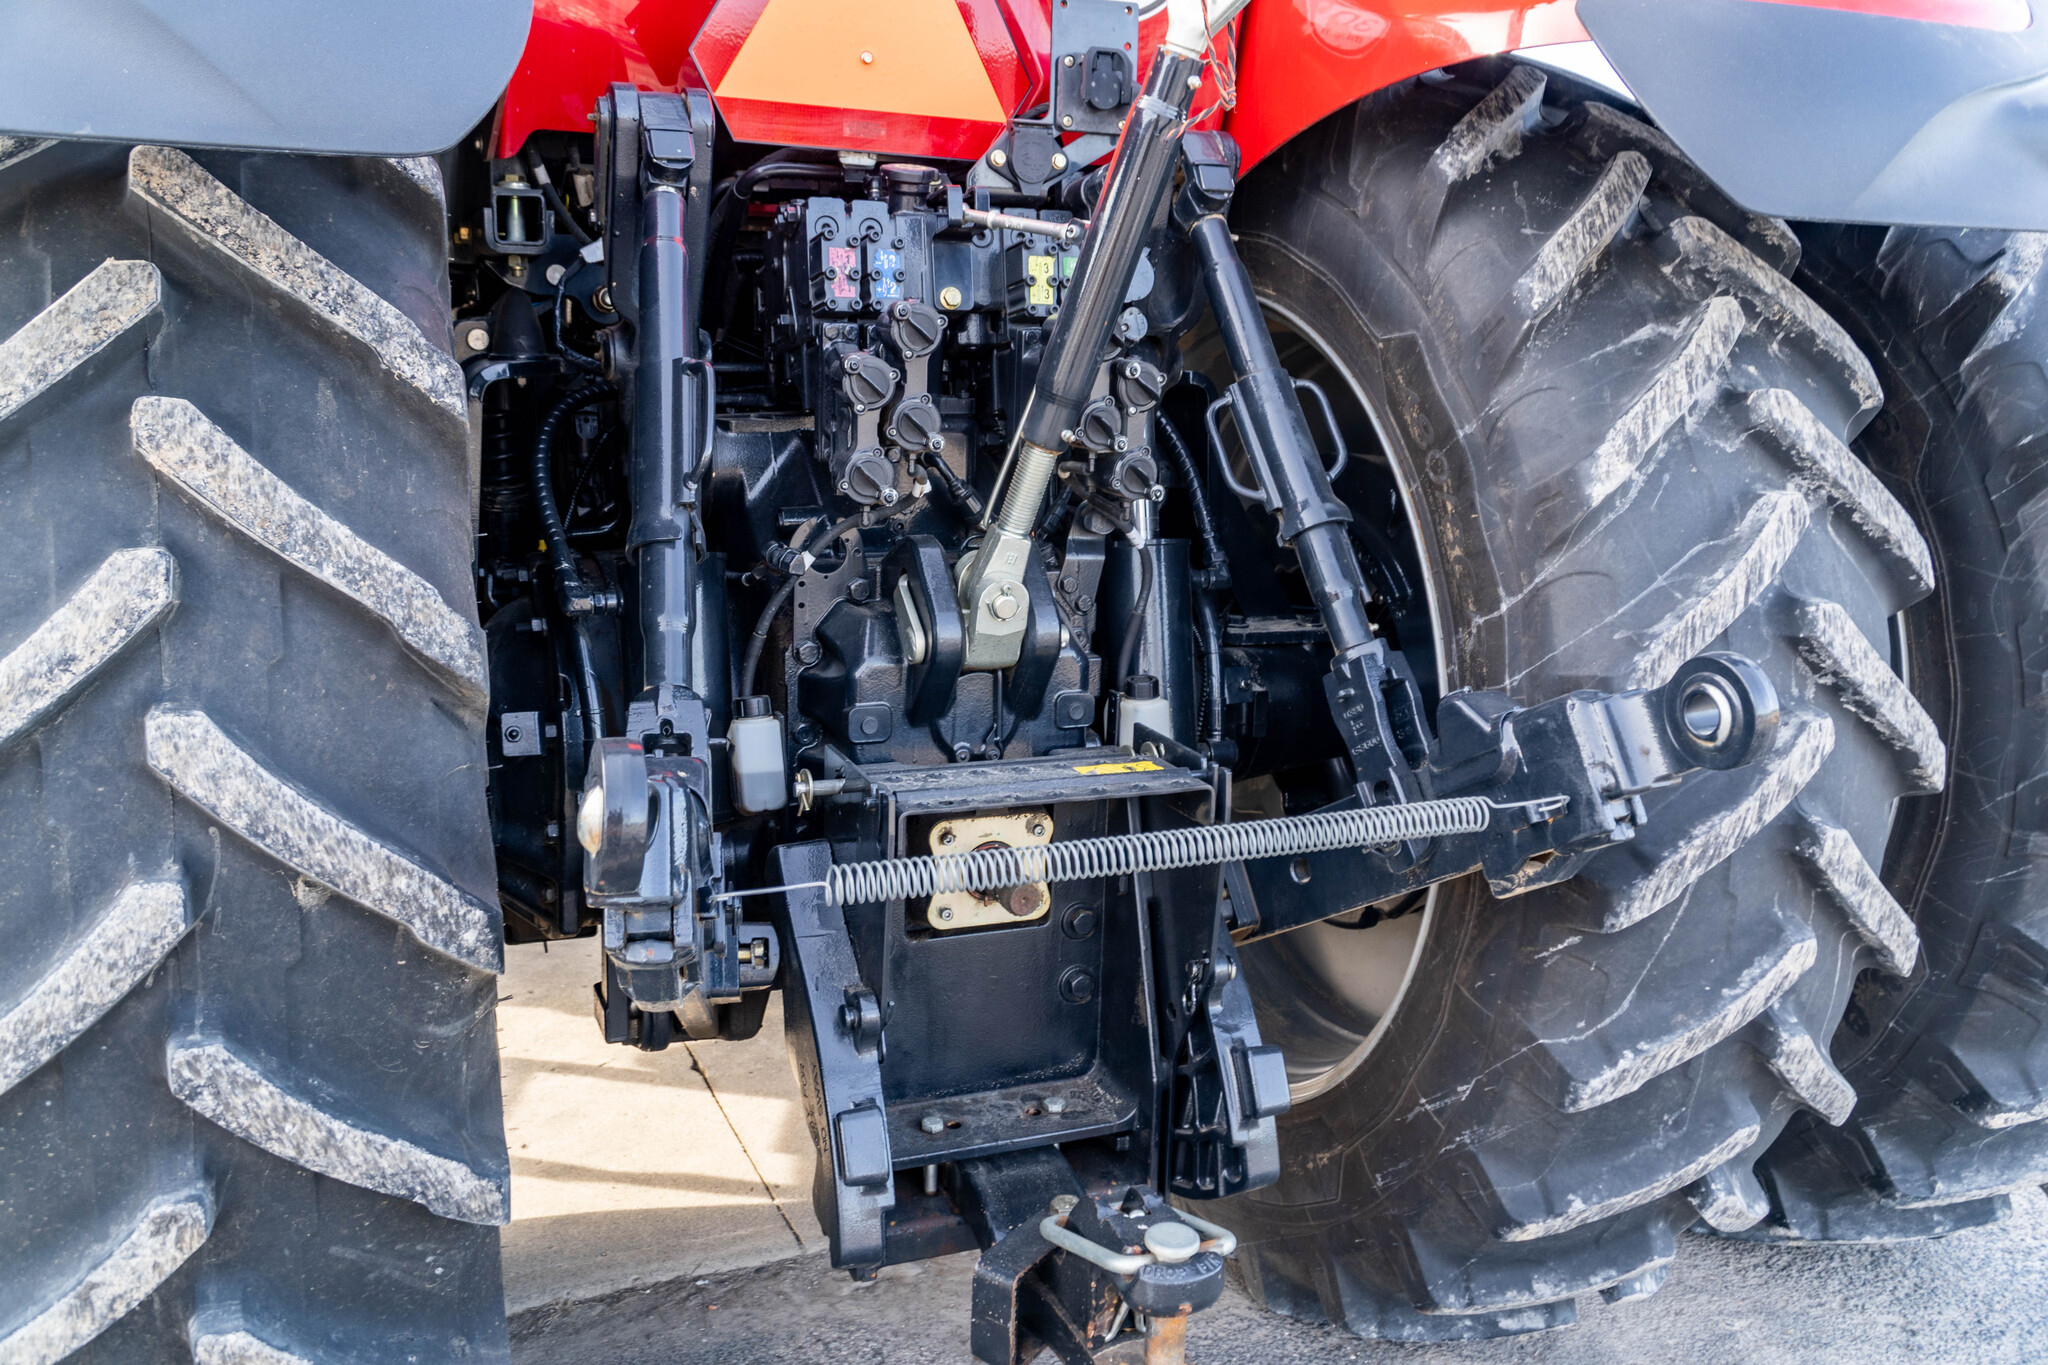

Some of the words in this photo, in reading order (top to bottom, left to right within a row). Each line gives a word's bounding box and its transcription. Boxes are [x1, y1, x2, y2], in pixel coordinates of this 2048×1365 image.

[1043, 262, 1049, 274] 3
[889, 281, 897, 294] 2
[1044, 288, 1050, 300] 3
